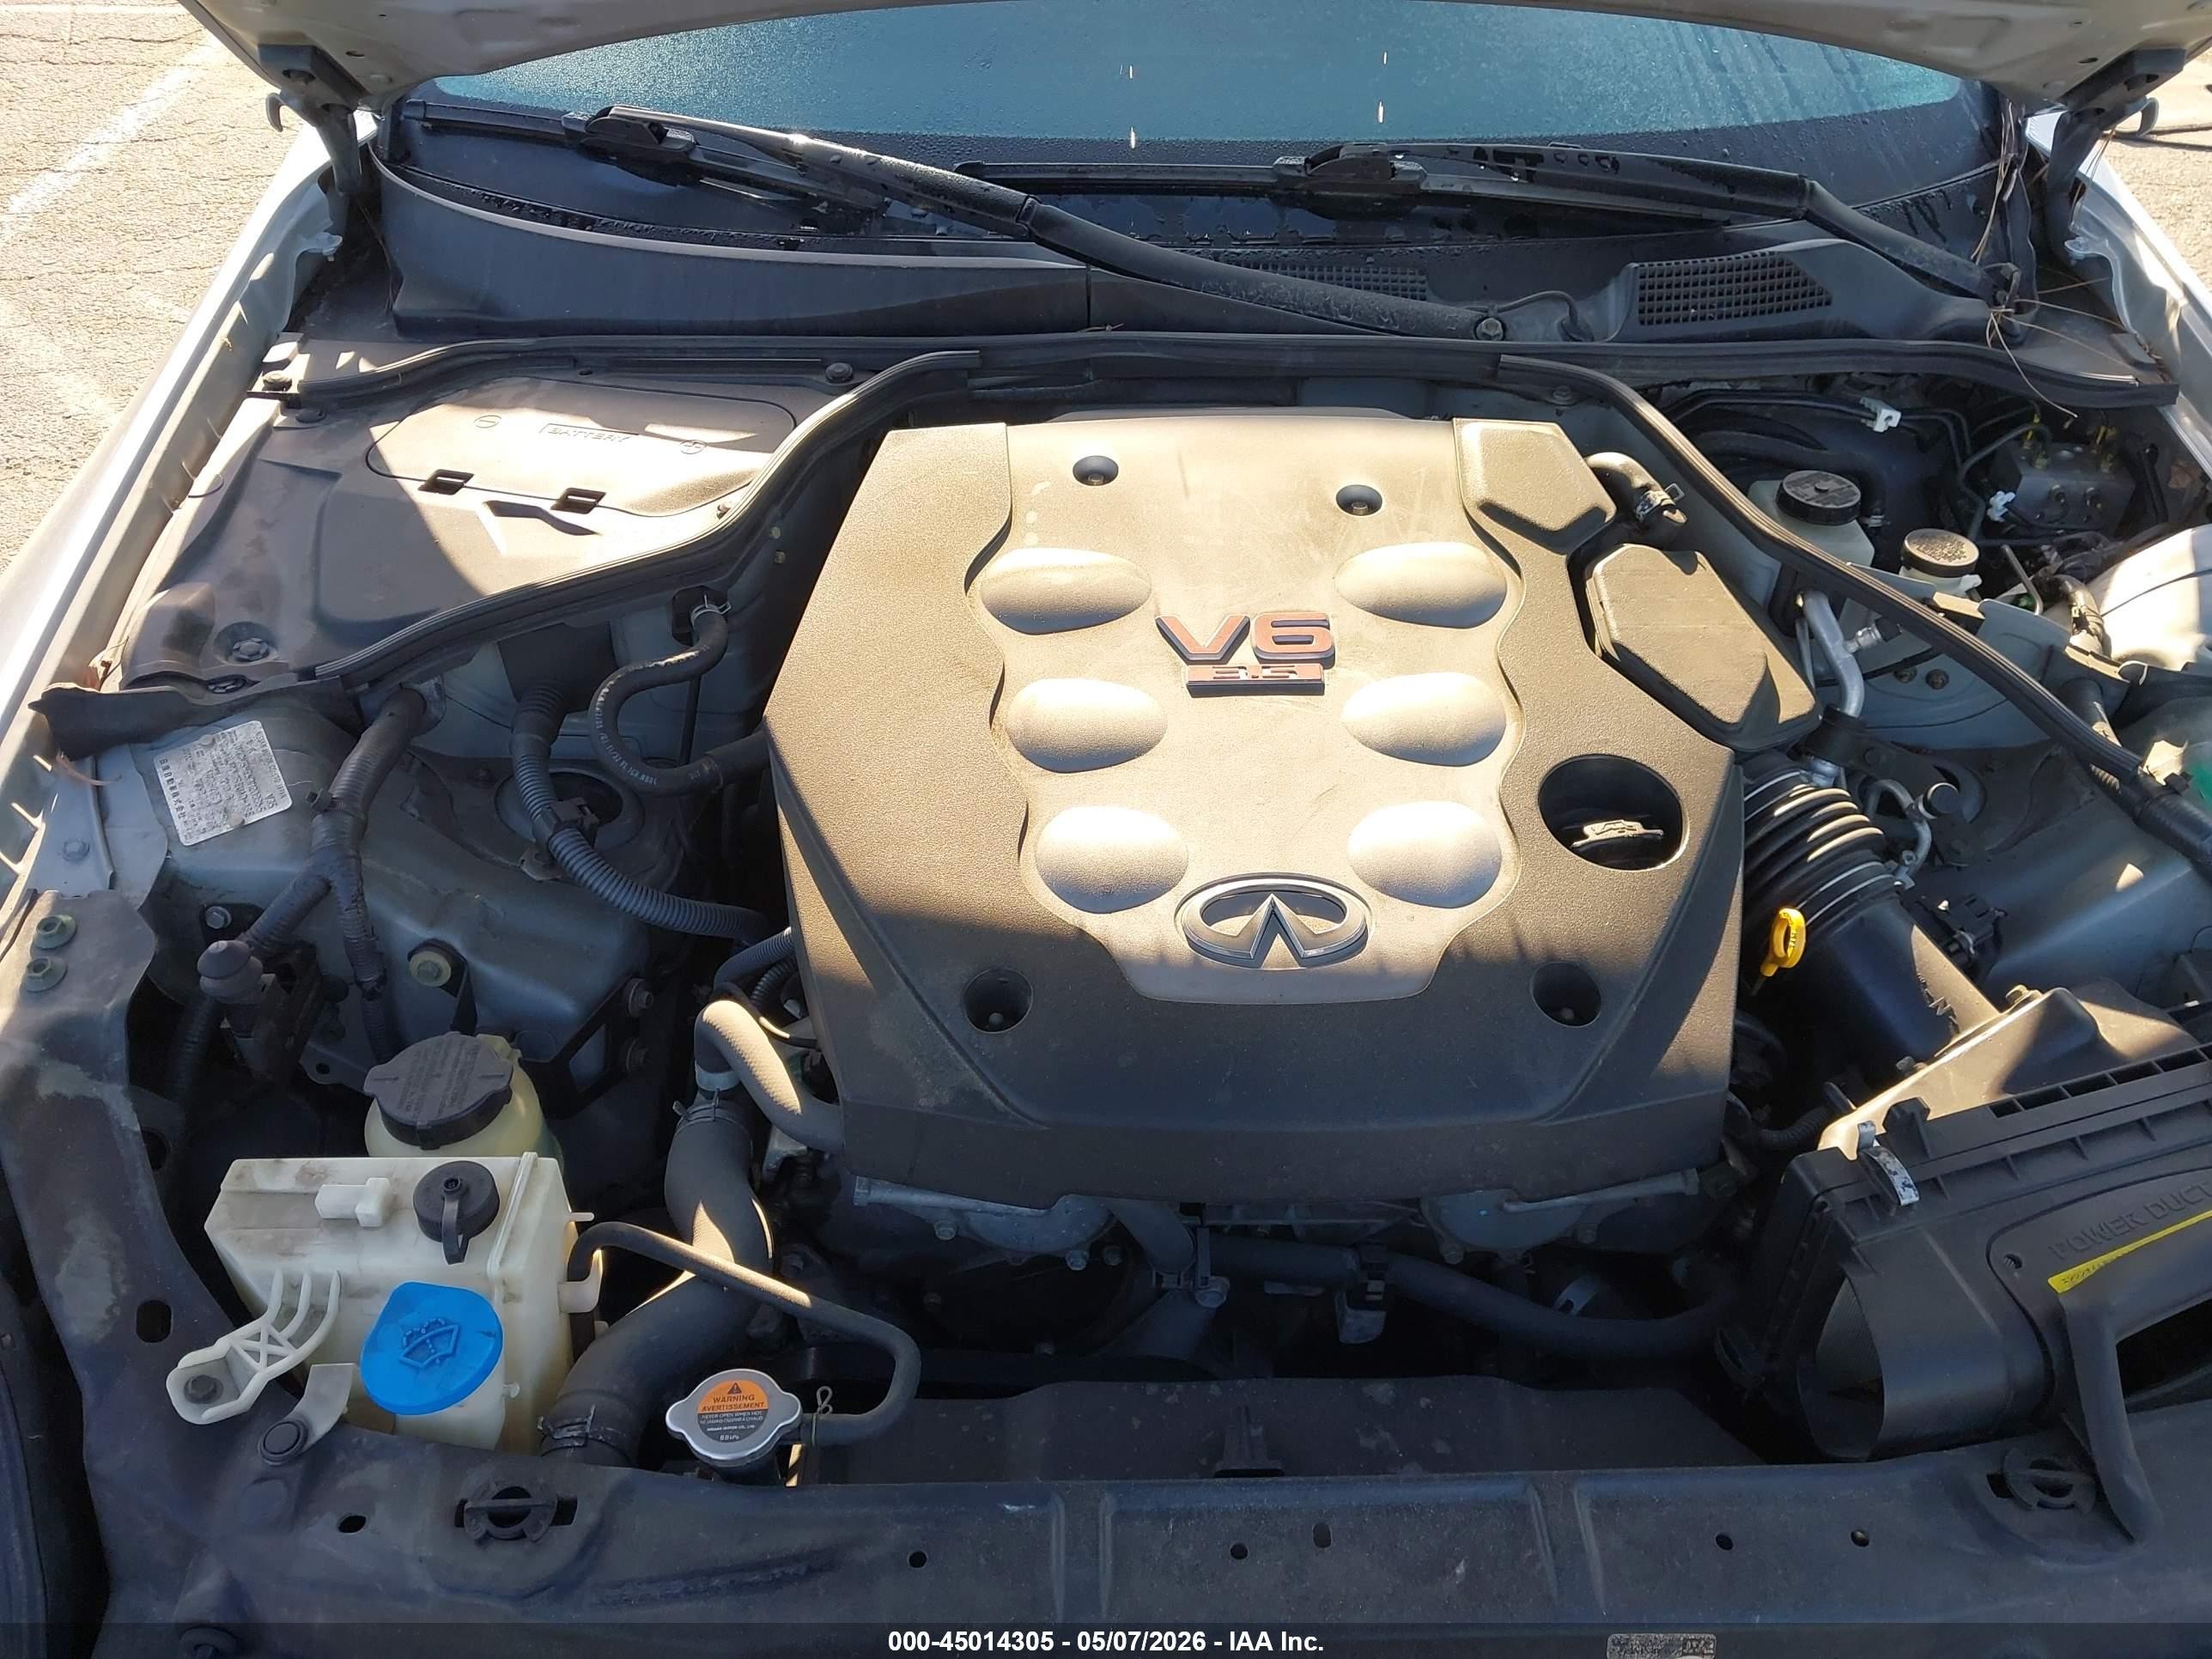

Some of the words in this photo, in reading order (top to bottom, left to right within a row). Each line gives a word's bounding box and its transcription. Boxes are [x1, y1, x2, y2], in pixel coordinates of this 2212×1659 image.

[548, 427, 631, 443] BATTERY
[1155, 611, 1335, 669] V6
[2047, 1212, 2149, 1260] POWER
[702, 1402, 764, 1412] AVERTISSEMENT
[714, 1395, 755, 1403] WARNING
